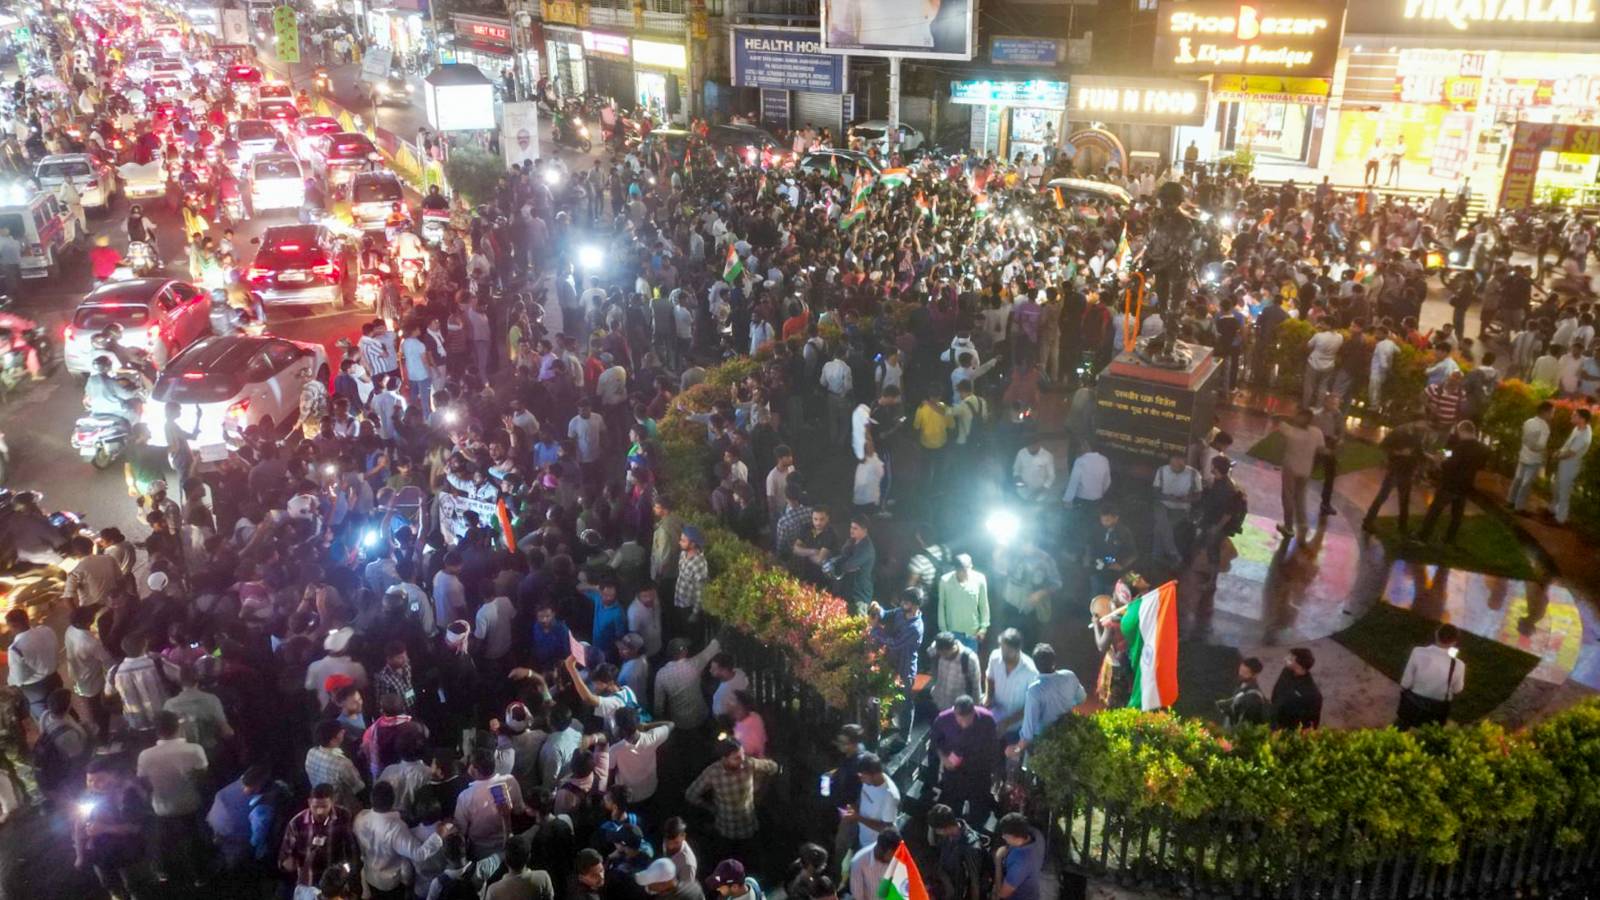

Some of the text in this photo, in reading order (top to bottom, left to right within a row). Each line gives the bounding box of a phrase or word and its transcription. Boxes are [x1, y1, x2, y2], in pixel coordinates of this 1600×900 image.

[1170, 12, 1236, 32] Shoe
[744, 38, 823, 54] HEALTH HOM
[1080, 88, 1117, 111] FUN
[1123, 90, 1139, 112] N
[1145, 90, 1197, 114] FOOD
[1254, 93, 1292, 101] ANNUAL
